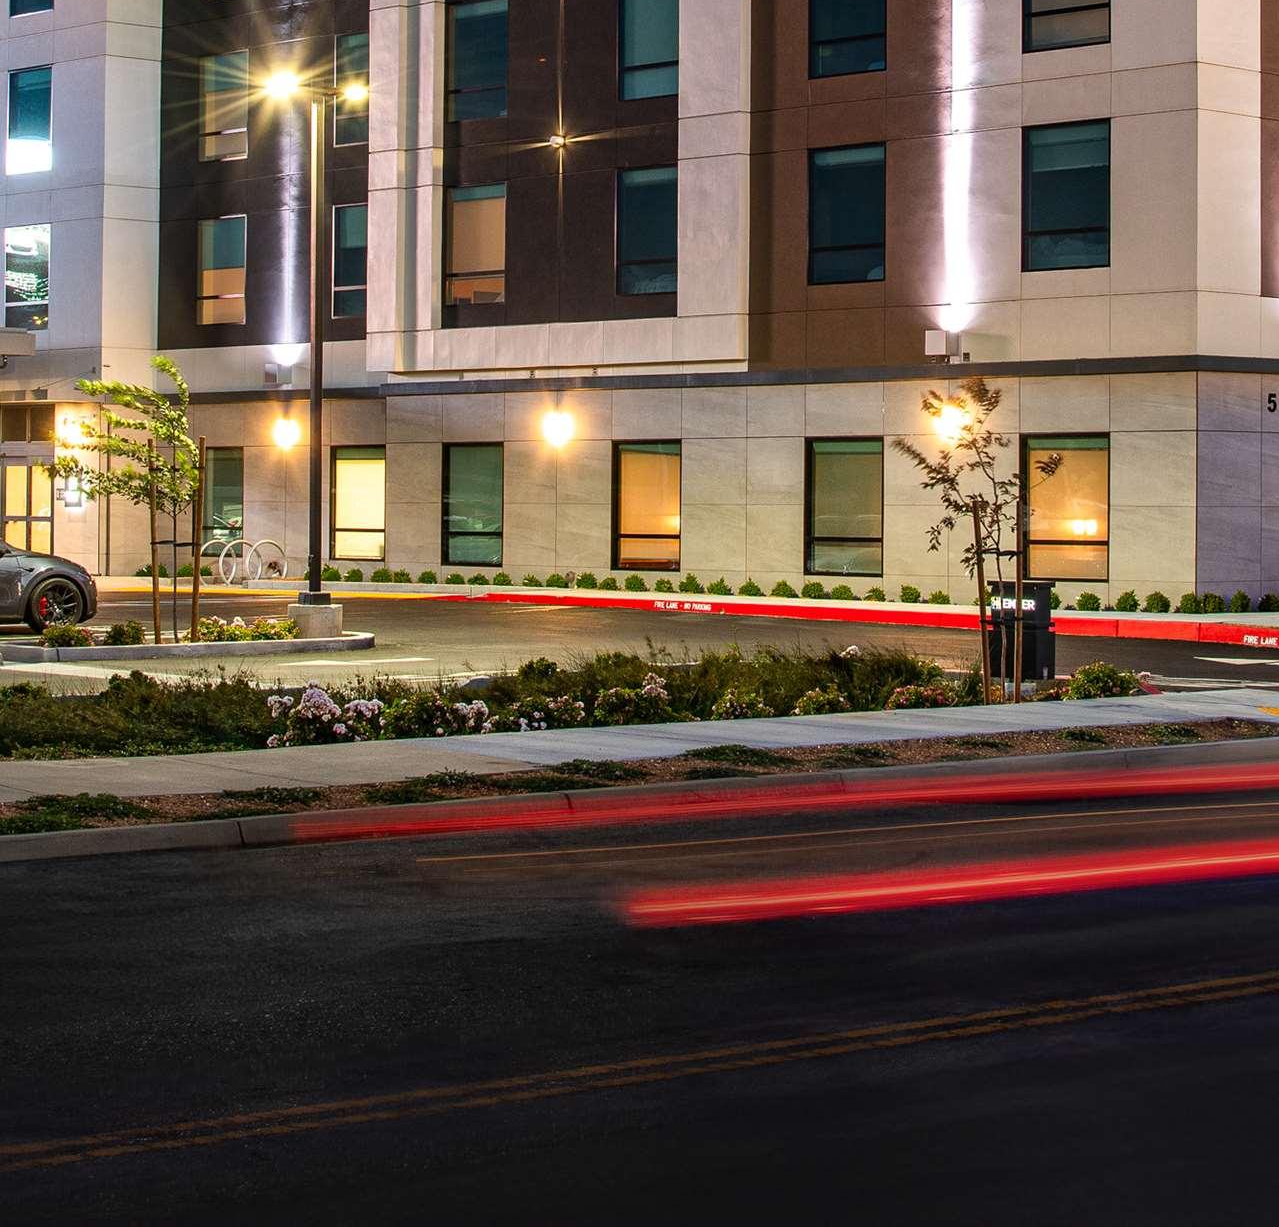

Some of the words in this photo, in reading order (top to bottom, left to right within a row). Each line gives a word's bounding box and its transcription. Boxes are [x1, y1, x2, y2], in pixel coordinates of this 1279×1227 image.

[1002, 598, 1035, 610] ENER
[1243, 634, 1259, 645] FIRE
[1260, 636, 1278, 645] LANE
